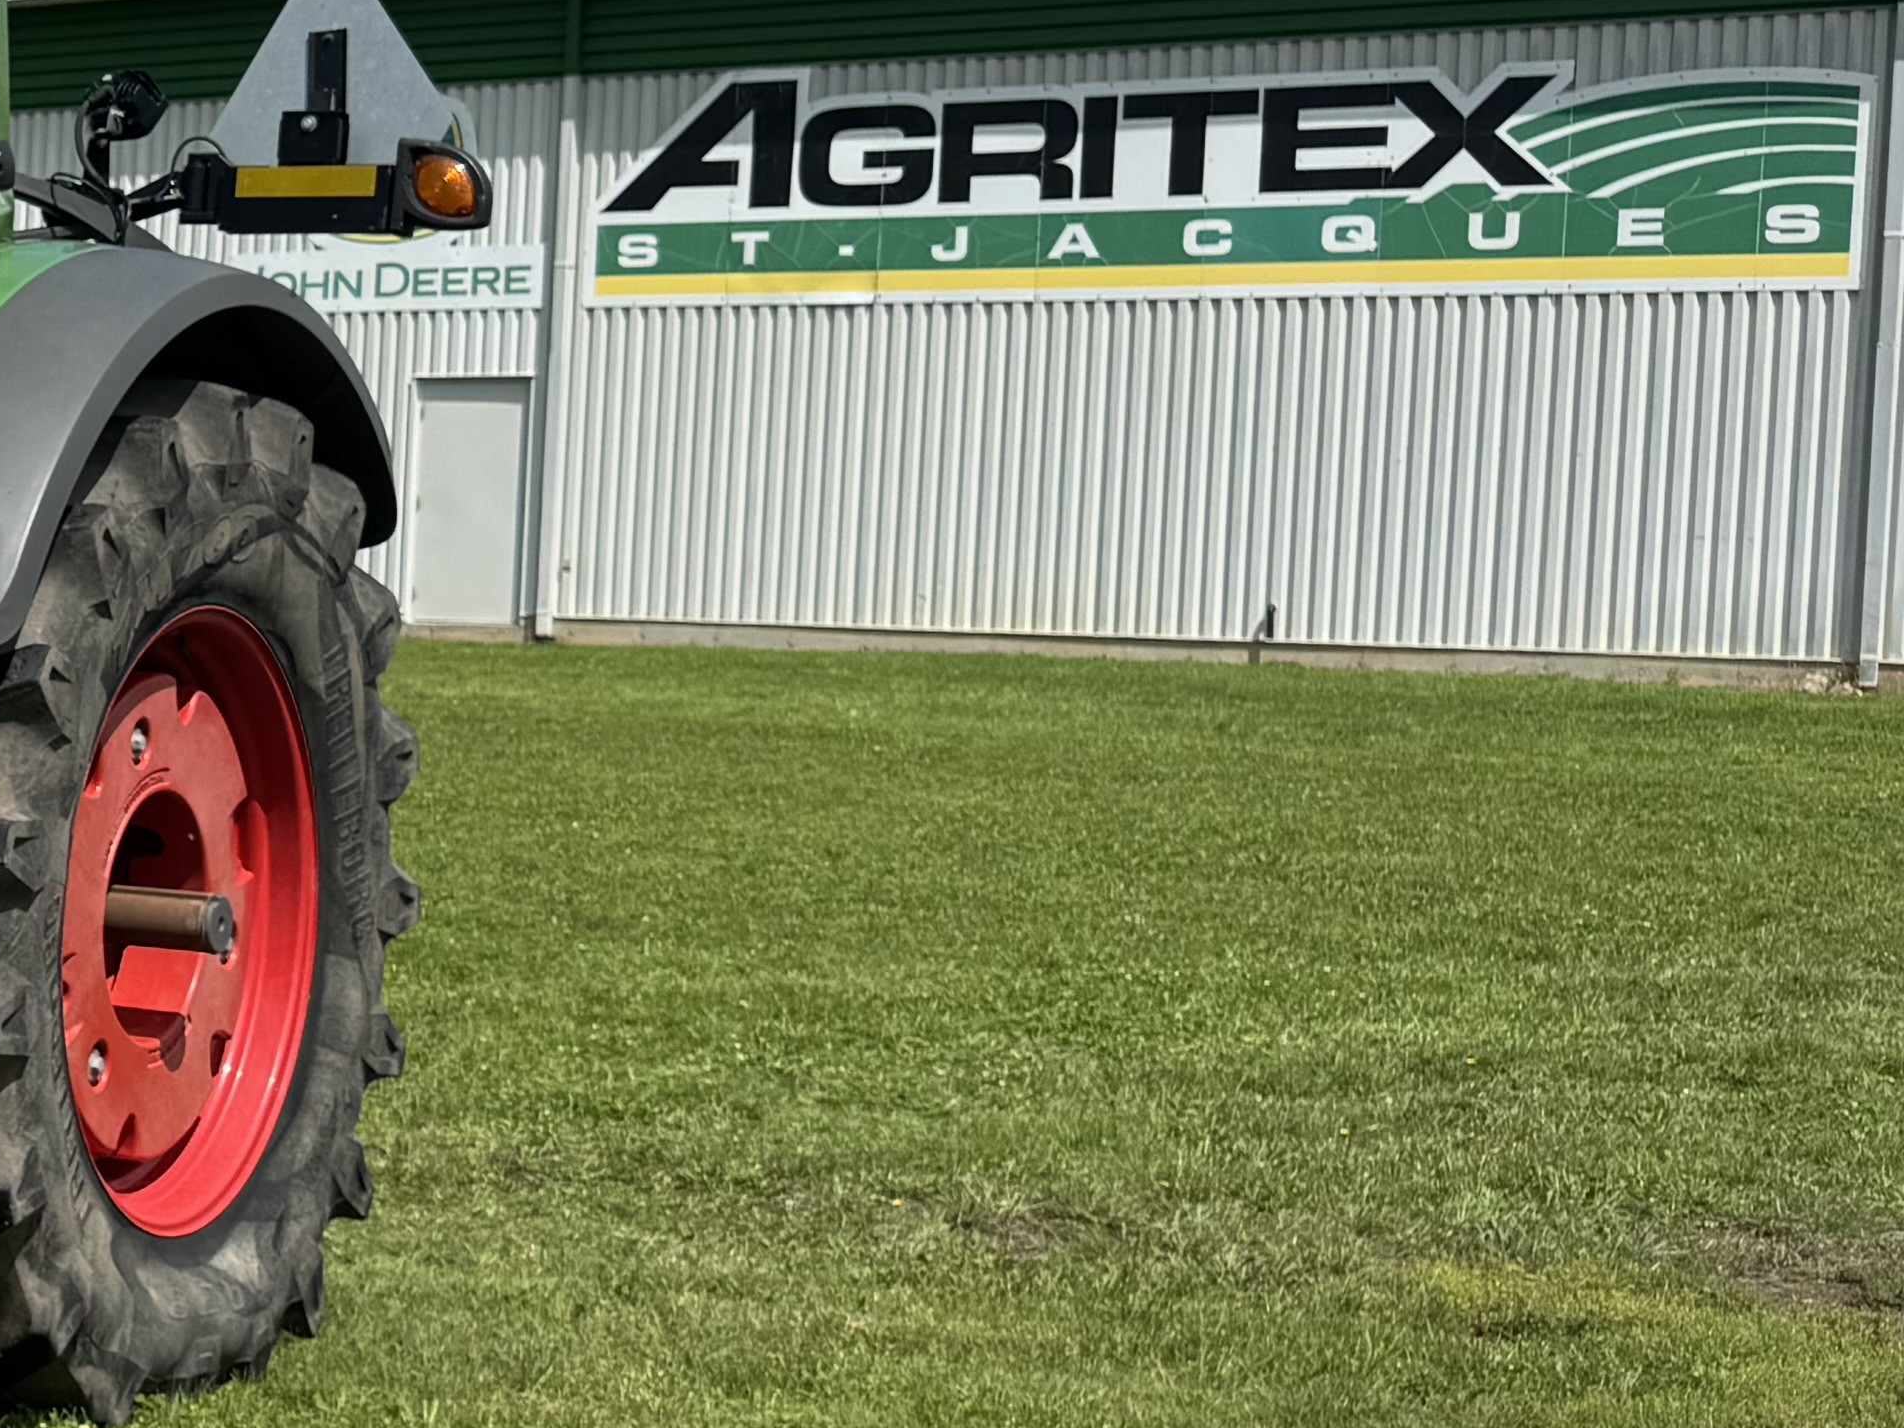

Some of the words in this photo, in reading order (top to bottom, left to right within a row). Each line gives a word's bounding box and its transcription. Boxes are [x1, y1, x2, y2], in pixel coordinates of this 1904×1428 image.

[600, 73, 1560, 214] AGRITEX
[256, 265, 363, 300] OHN
[374, 261, 532, 298] DEERE
